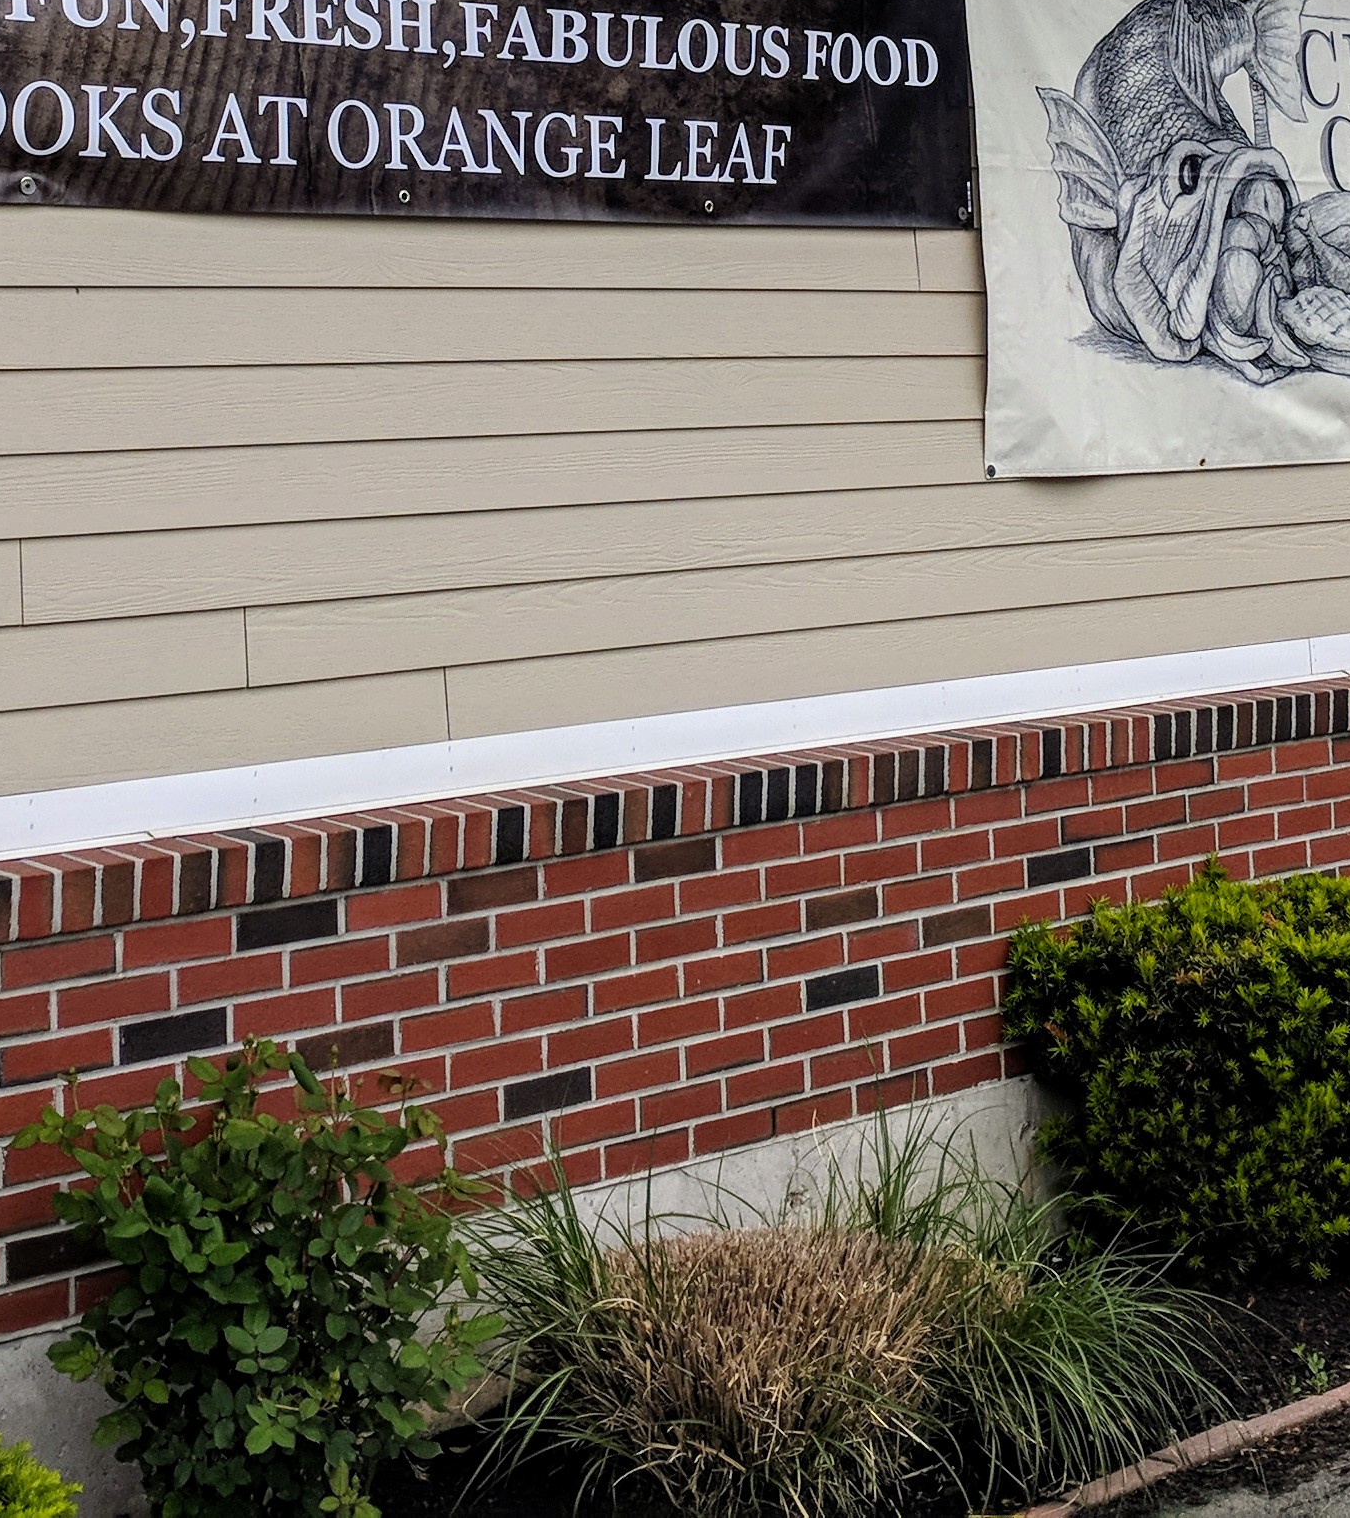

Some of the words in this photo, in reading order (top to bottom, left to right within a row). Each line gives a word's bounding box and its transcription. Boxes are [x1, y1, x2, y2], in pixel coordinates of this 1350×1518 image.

[802, 29, 939, 87] FOOD
[201, 92, 308, 166] AT
[327, 99, 626, 180] ORANGE
[643, 117, 792, 185] LEAF
